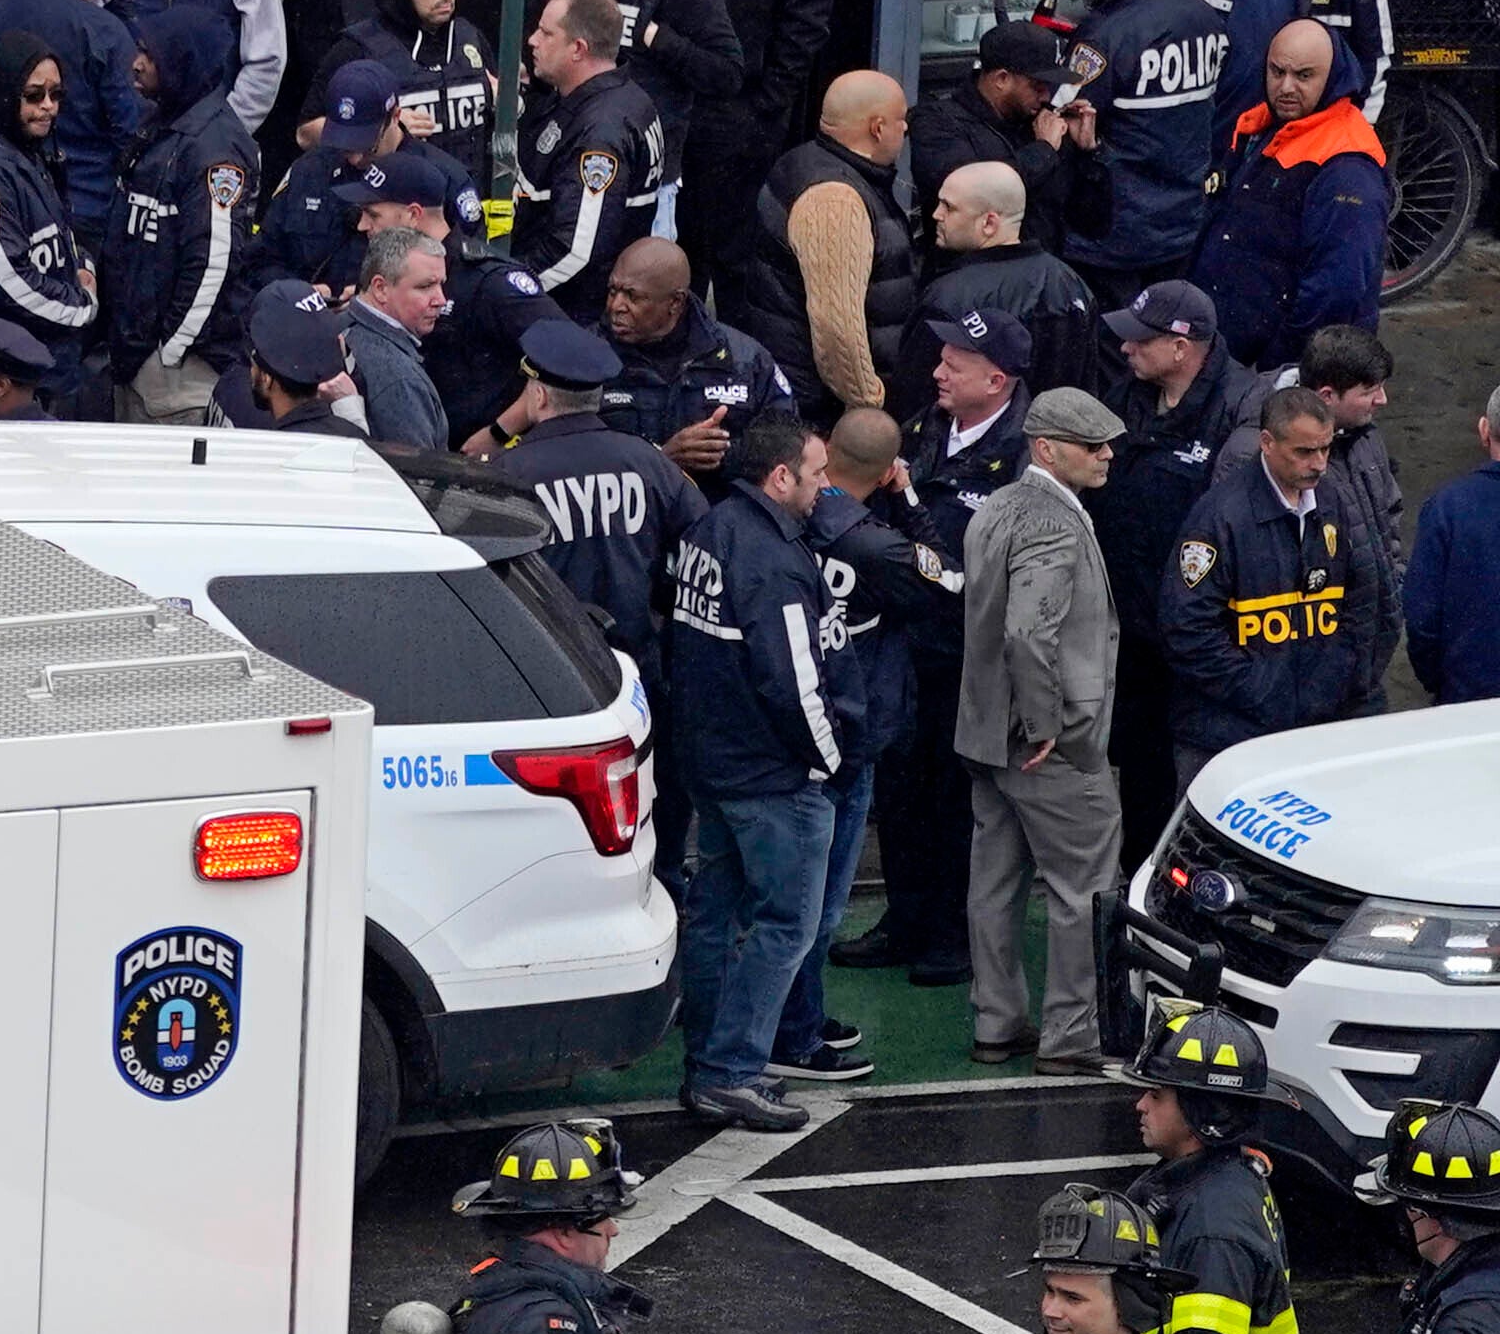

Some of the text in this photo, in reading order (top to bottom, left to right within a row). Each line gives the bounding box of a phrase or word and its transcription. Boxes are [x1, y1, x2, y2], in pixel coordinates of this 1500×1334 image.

[1136, 33, 1229, 96] POLICE
[534, 471, 647, 545] NYPD
[123, 935, 235, 987] POLICE
[149, 976, 208, 1002] NYPD
[120, 1039, 230, 1094] BOMB SQUAD
[162, 1055, 188, 1067] 1903
